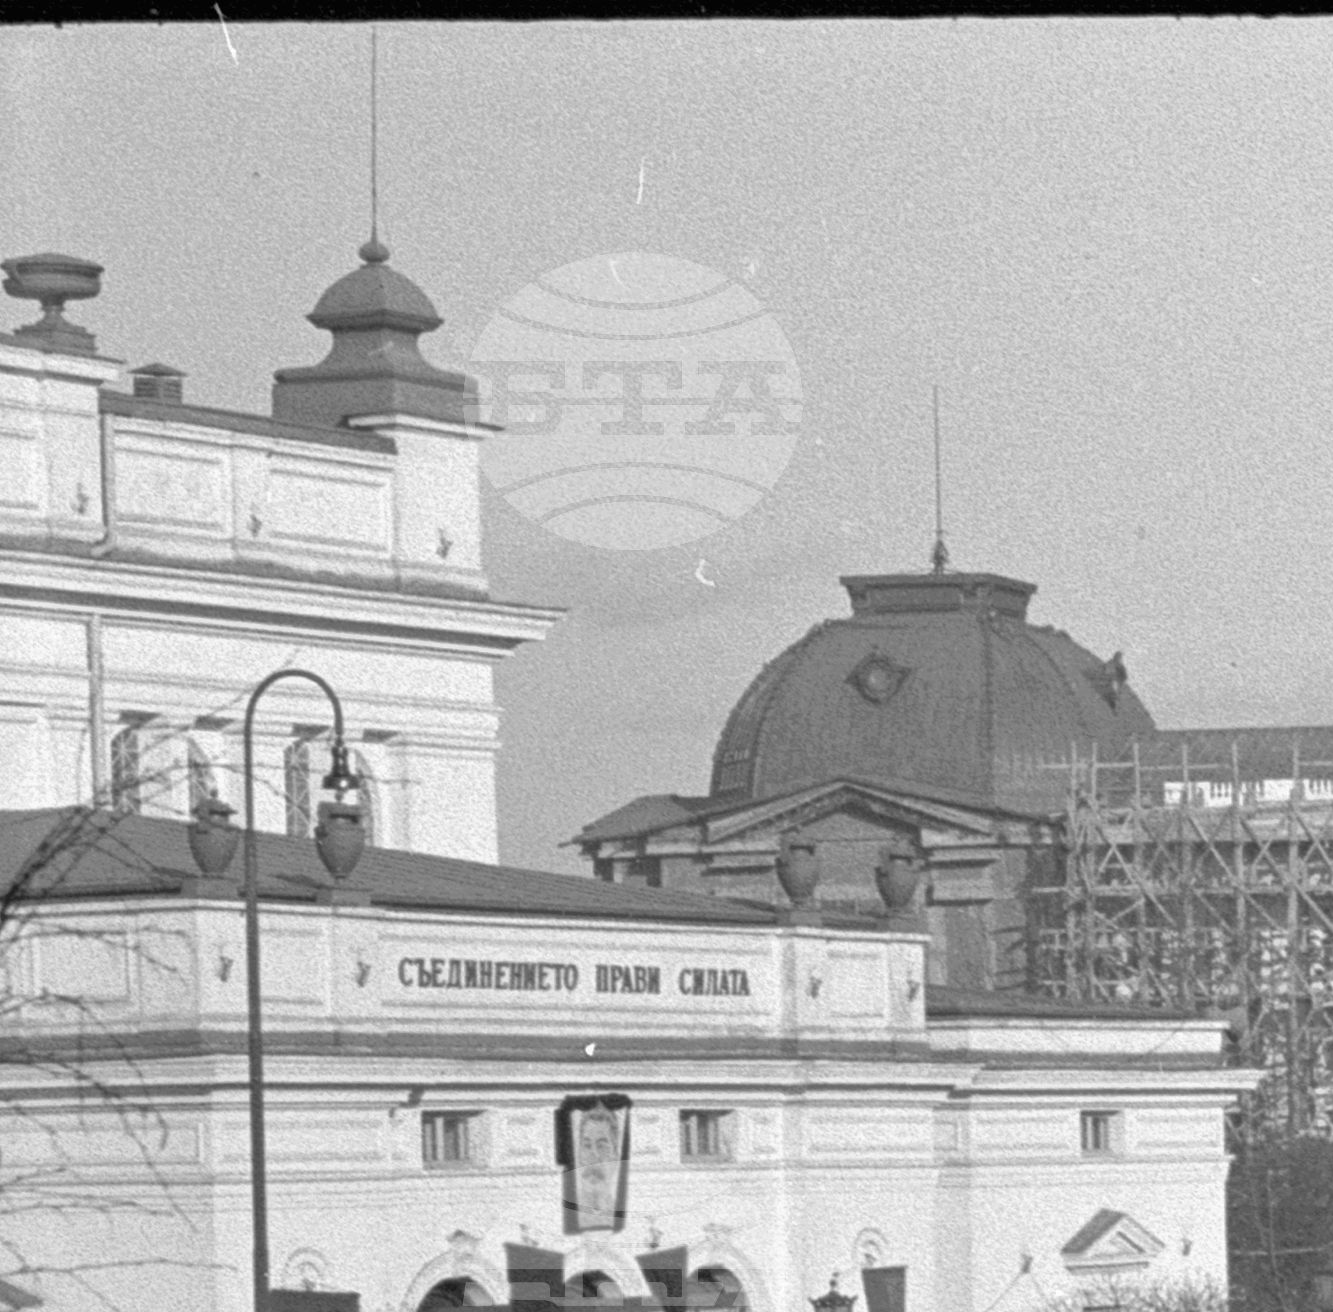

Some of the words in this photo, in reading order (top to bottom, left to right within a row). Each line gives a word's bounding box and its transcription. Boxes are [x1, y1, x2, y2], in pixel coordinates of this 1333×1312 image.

[399, 957, 580, 991] СЪЕДИНЕНИЕТО
[596, 964, 661, 995] ПРАВИ
[679, 968, 751, 997] СИЛАТА
